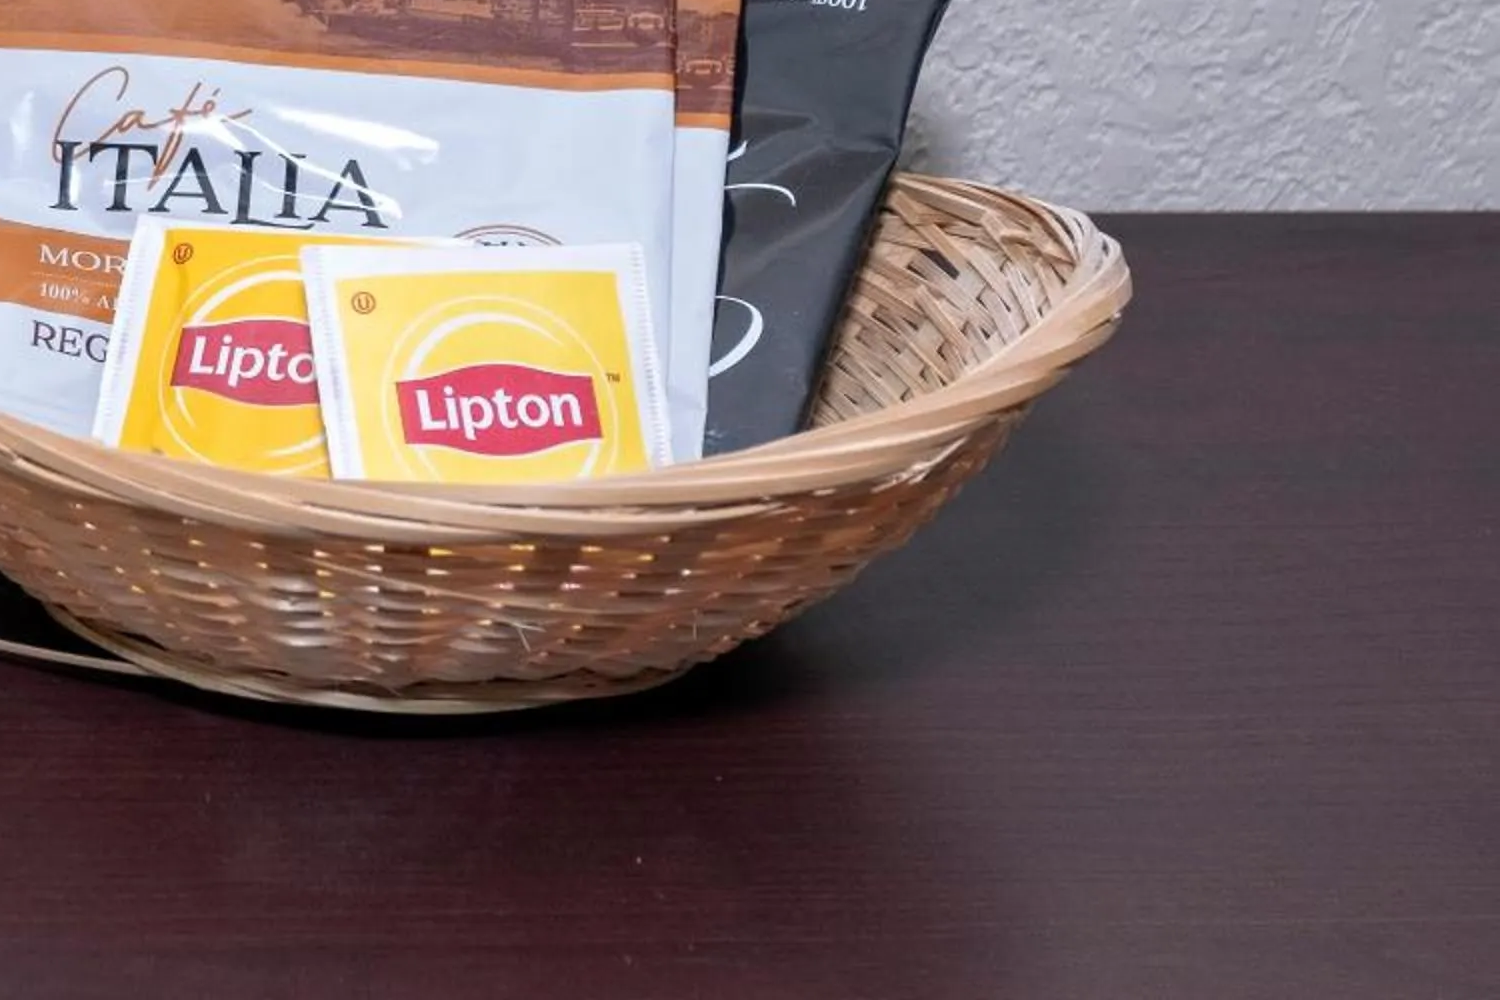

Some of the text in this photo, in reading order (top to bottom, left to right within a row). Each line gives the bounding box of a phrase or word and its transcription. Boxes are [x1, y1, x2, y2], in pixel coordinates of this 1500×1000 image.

[52, 66, 253, 192] Café
[49, 141, 389, 230] ITALIA
[39, 244, 127, 273] MOR
[40, 283, 90, 304] 100%
[31, 319, 110, 363] REG
[189, 334, 317, 388] Lipto
[415, 385, 583, 441] Lipton
